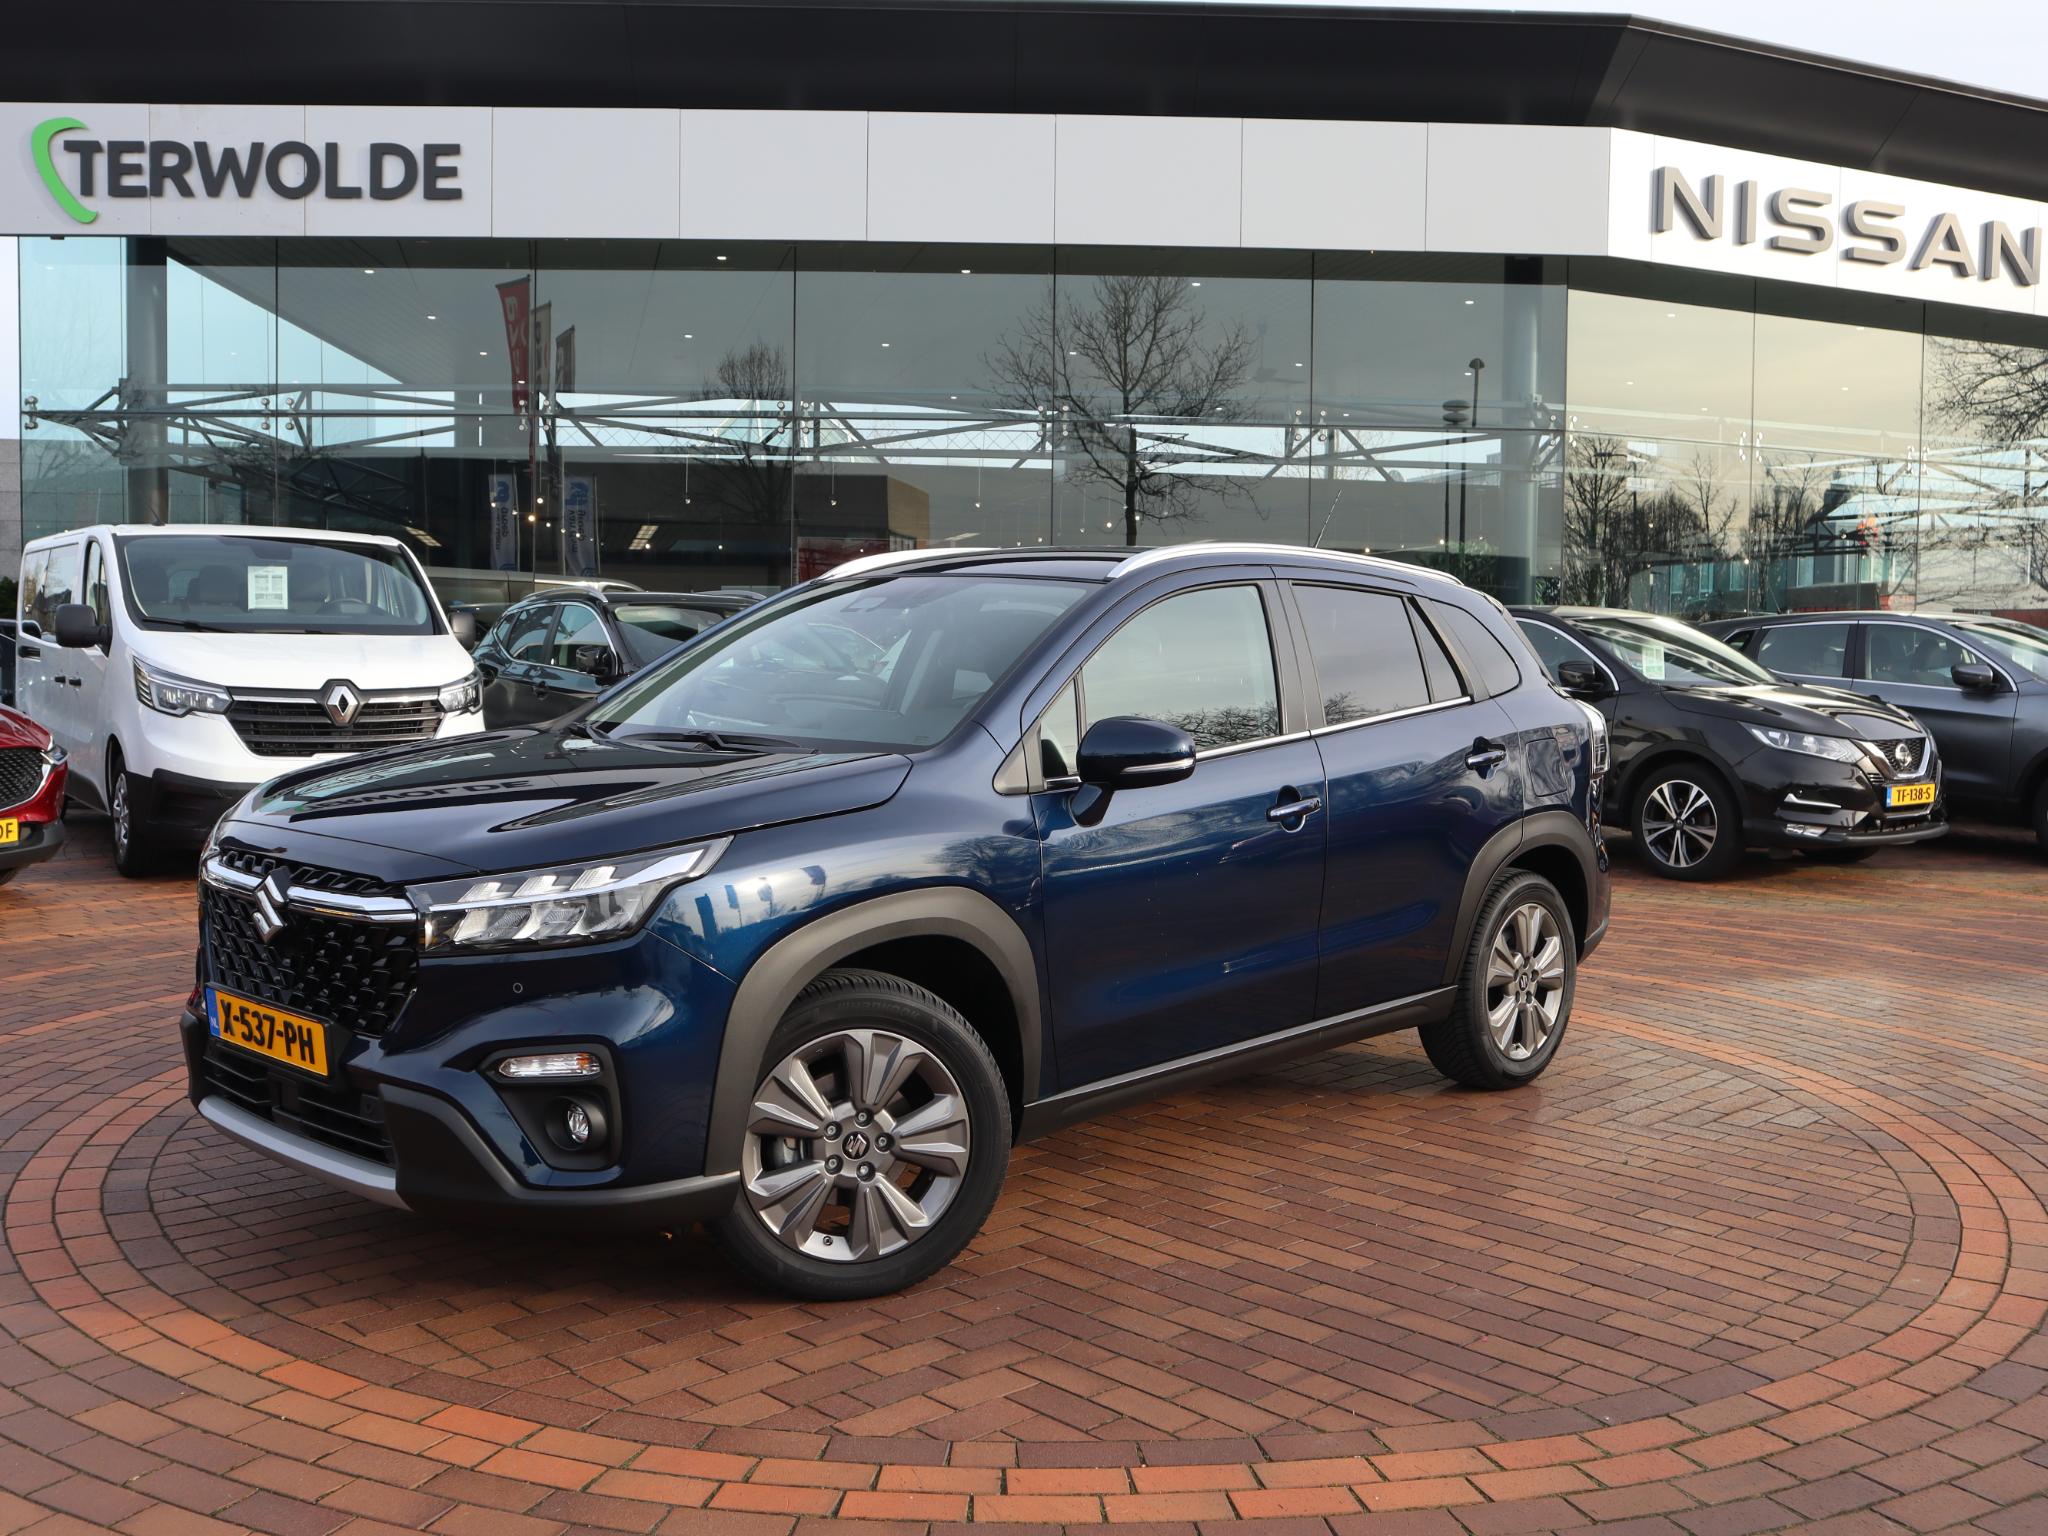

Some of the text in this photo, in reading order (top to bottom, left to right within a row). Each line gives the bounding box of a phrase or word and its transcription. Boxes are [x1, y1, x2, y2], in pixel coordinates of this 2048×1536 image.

[63, 140, 463, 200] TERWOLDE
[1654, 166, 2042, 287] NISSAN
[1896, 786, 1931, 802] TF-138-S
[220, 999, 315, 1064] X-537-PH
